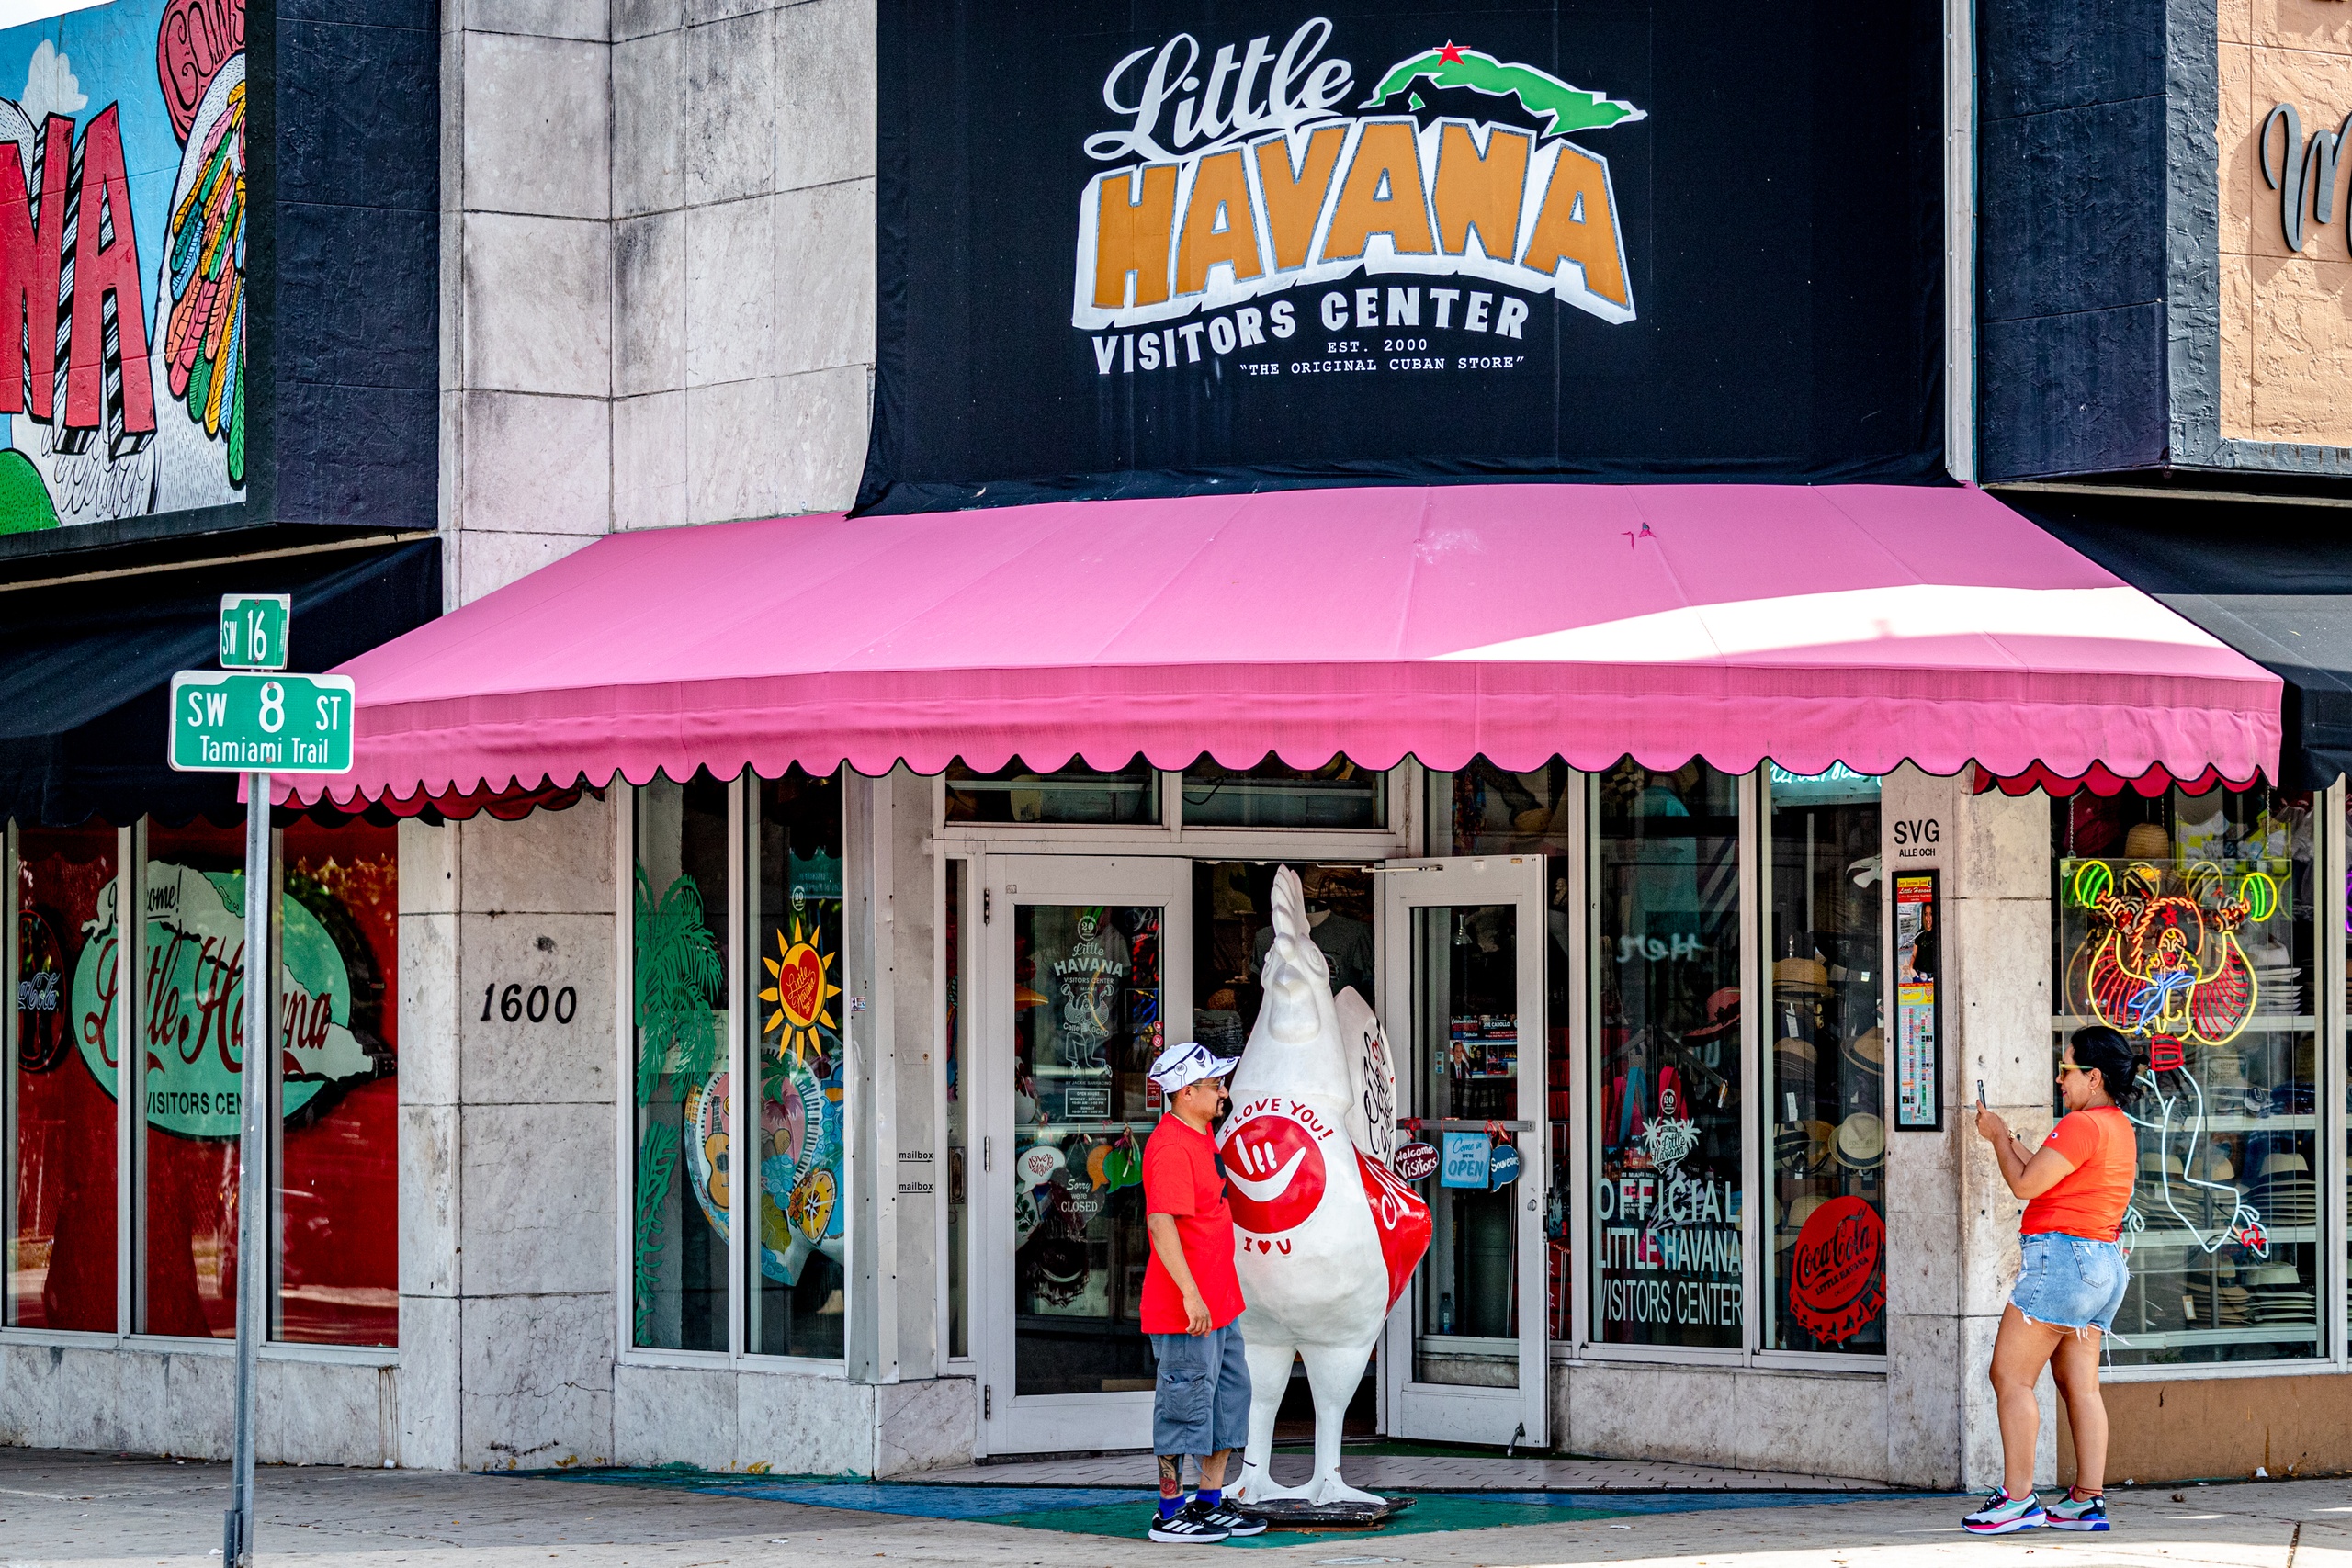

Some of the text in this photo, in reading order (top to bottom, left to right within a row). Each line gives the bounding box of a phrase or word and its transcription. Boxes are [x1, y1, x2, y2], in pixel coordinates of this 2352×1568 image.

[1084, 17, 1354, 161] Little
[1072, 117, 1636, 329] HAVANA
[1091, 287, 1529, 375] VISITORS CENTER
[1327, 338, 1428, 353] EST. 2000
[1291, 359, 1377, 373] ORIGINAL
[1389, 358, 1445, 370] CUBAN
[222, 620, 238, 655] SW
[247, 609, 267, 660] 16
[187, 681, 342, 733] SW 8 ST
[199, 735, 329, 764] Tamiami Trail
[1894, 818, 1939, 844] SVG
[1899, 847, 1936, 857] ALLE OCH
[1081, 921, 1094, 931] 20
[1072, 942, 1104, 956] Little
[1054, 957, 1123, 977] HAVANA
[178, 936, 332, 1073] Hana
[480, 983, 577, 1024] 1600
[1664, 1095, 1675, 1104] 20
[1234, 1098, 1282, 1123] LOVE
[1290, 1100, 1334, 1141] YOU!
[1452, 1137, 1474, 1154] Come
[1661, 1132, 1686, 1152] Little
[899, 1151, 933, 1159] mailbox
[1395, 1145, 1434, 1163] Welcome
[1652, 1146, 1687, 1162] Havana
[1396, 1157, 1438, 1179] Visitors
[1448, 1159, 1484, 1177] OPEN
[899, 1182, 933, 1190] mailbox
[1066, 1179, 1091, 1192] Sorry
[1061, 1201, 1098, 1213] CLOSED
[1595, 1179, 1741, 1223] OFFICIAL
[1595, 1227, 1743, 1273] LITTLE HAVANA
[1598, 1279, 1743, 1326] VISITORS CENTER
